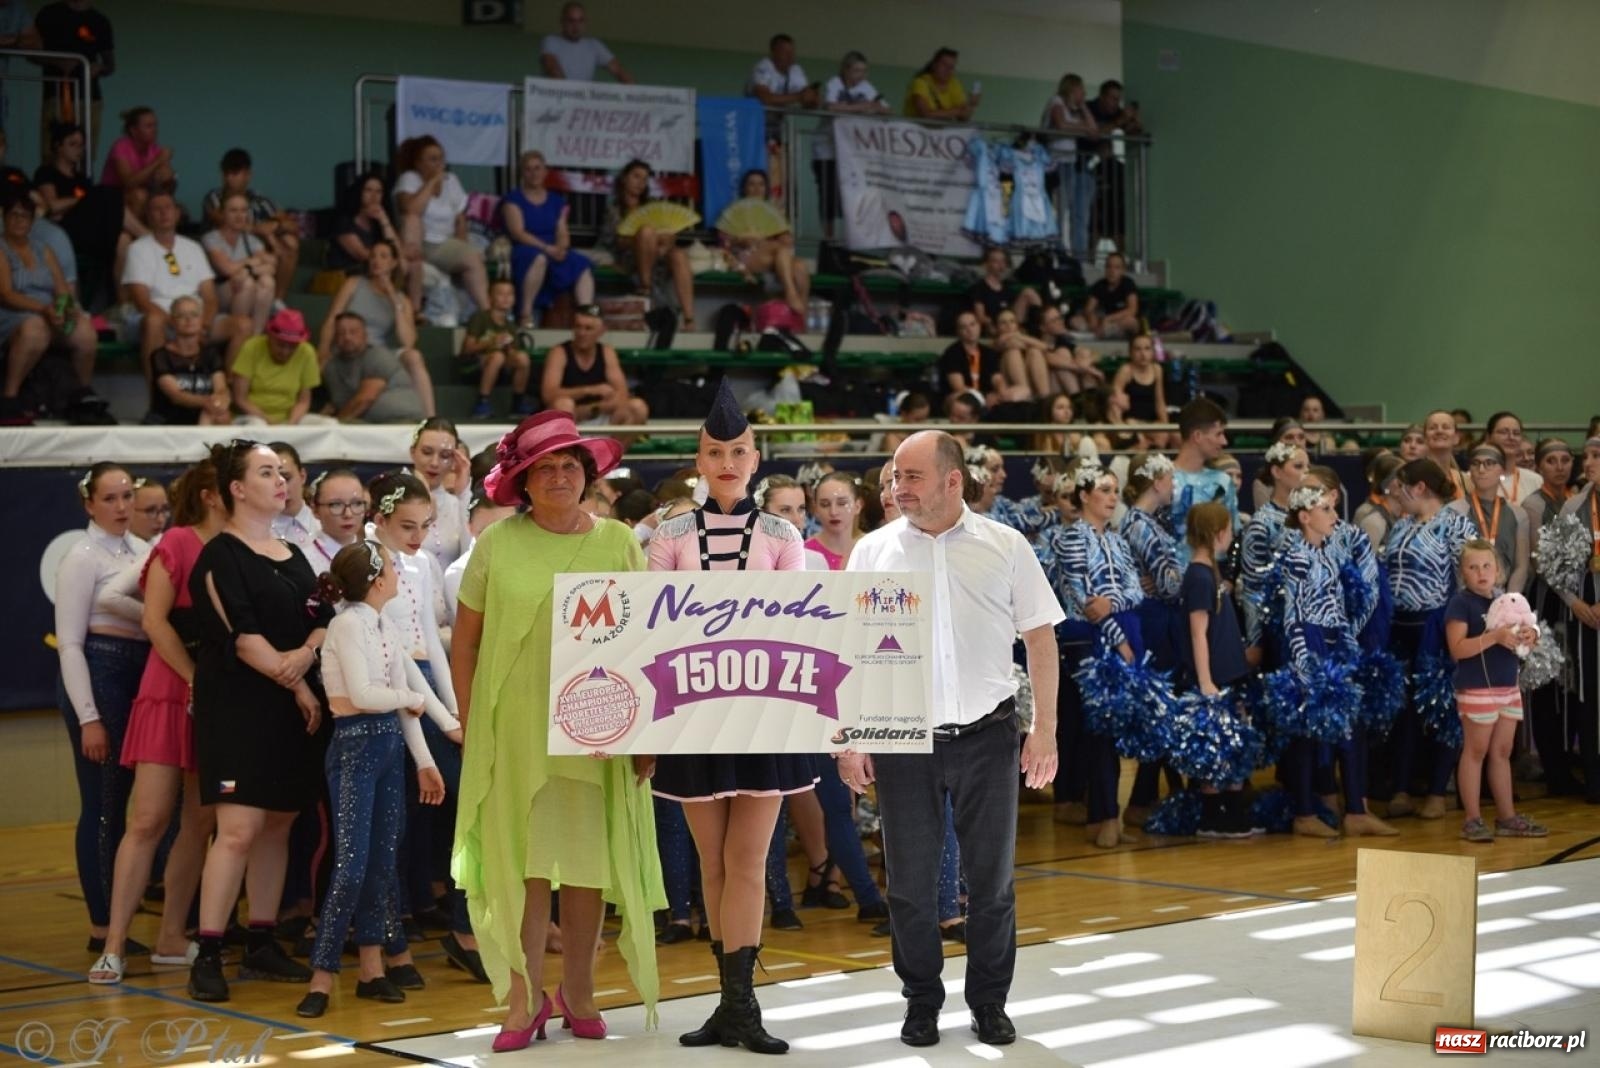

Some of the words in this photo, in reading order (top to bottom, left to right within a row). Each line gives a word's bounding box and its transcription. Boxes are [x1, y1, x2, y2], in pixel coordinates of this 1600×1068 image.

[474, 1, 501, 21] D
[567, 108, 653, 136] FINEZJA
[555, 134, 663, 162] NAJLEPSZA
[569, 579, 605, 595] SPORTOWY
[646, 583, 848, 637] Nagroda
[668, 649, 770, 694] 1500
[778, 650, 820, 694] ZŁ
[560, 692, 630, 713] CHAMPIONSHIP
[580, 683, 629, 699] EUROPEAN
[554, 705, 609, 724] MAJORETTES
[609, 697, 640, 711] SPORT
[831, 728, 927, 745] Solidaris
[1380, 891, 1445, 1008] 2
